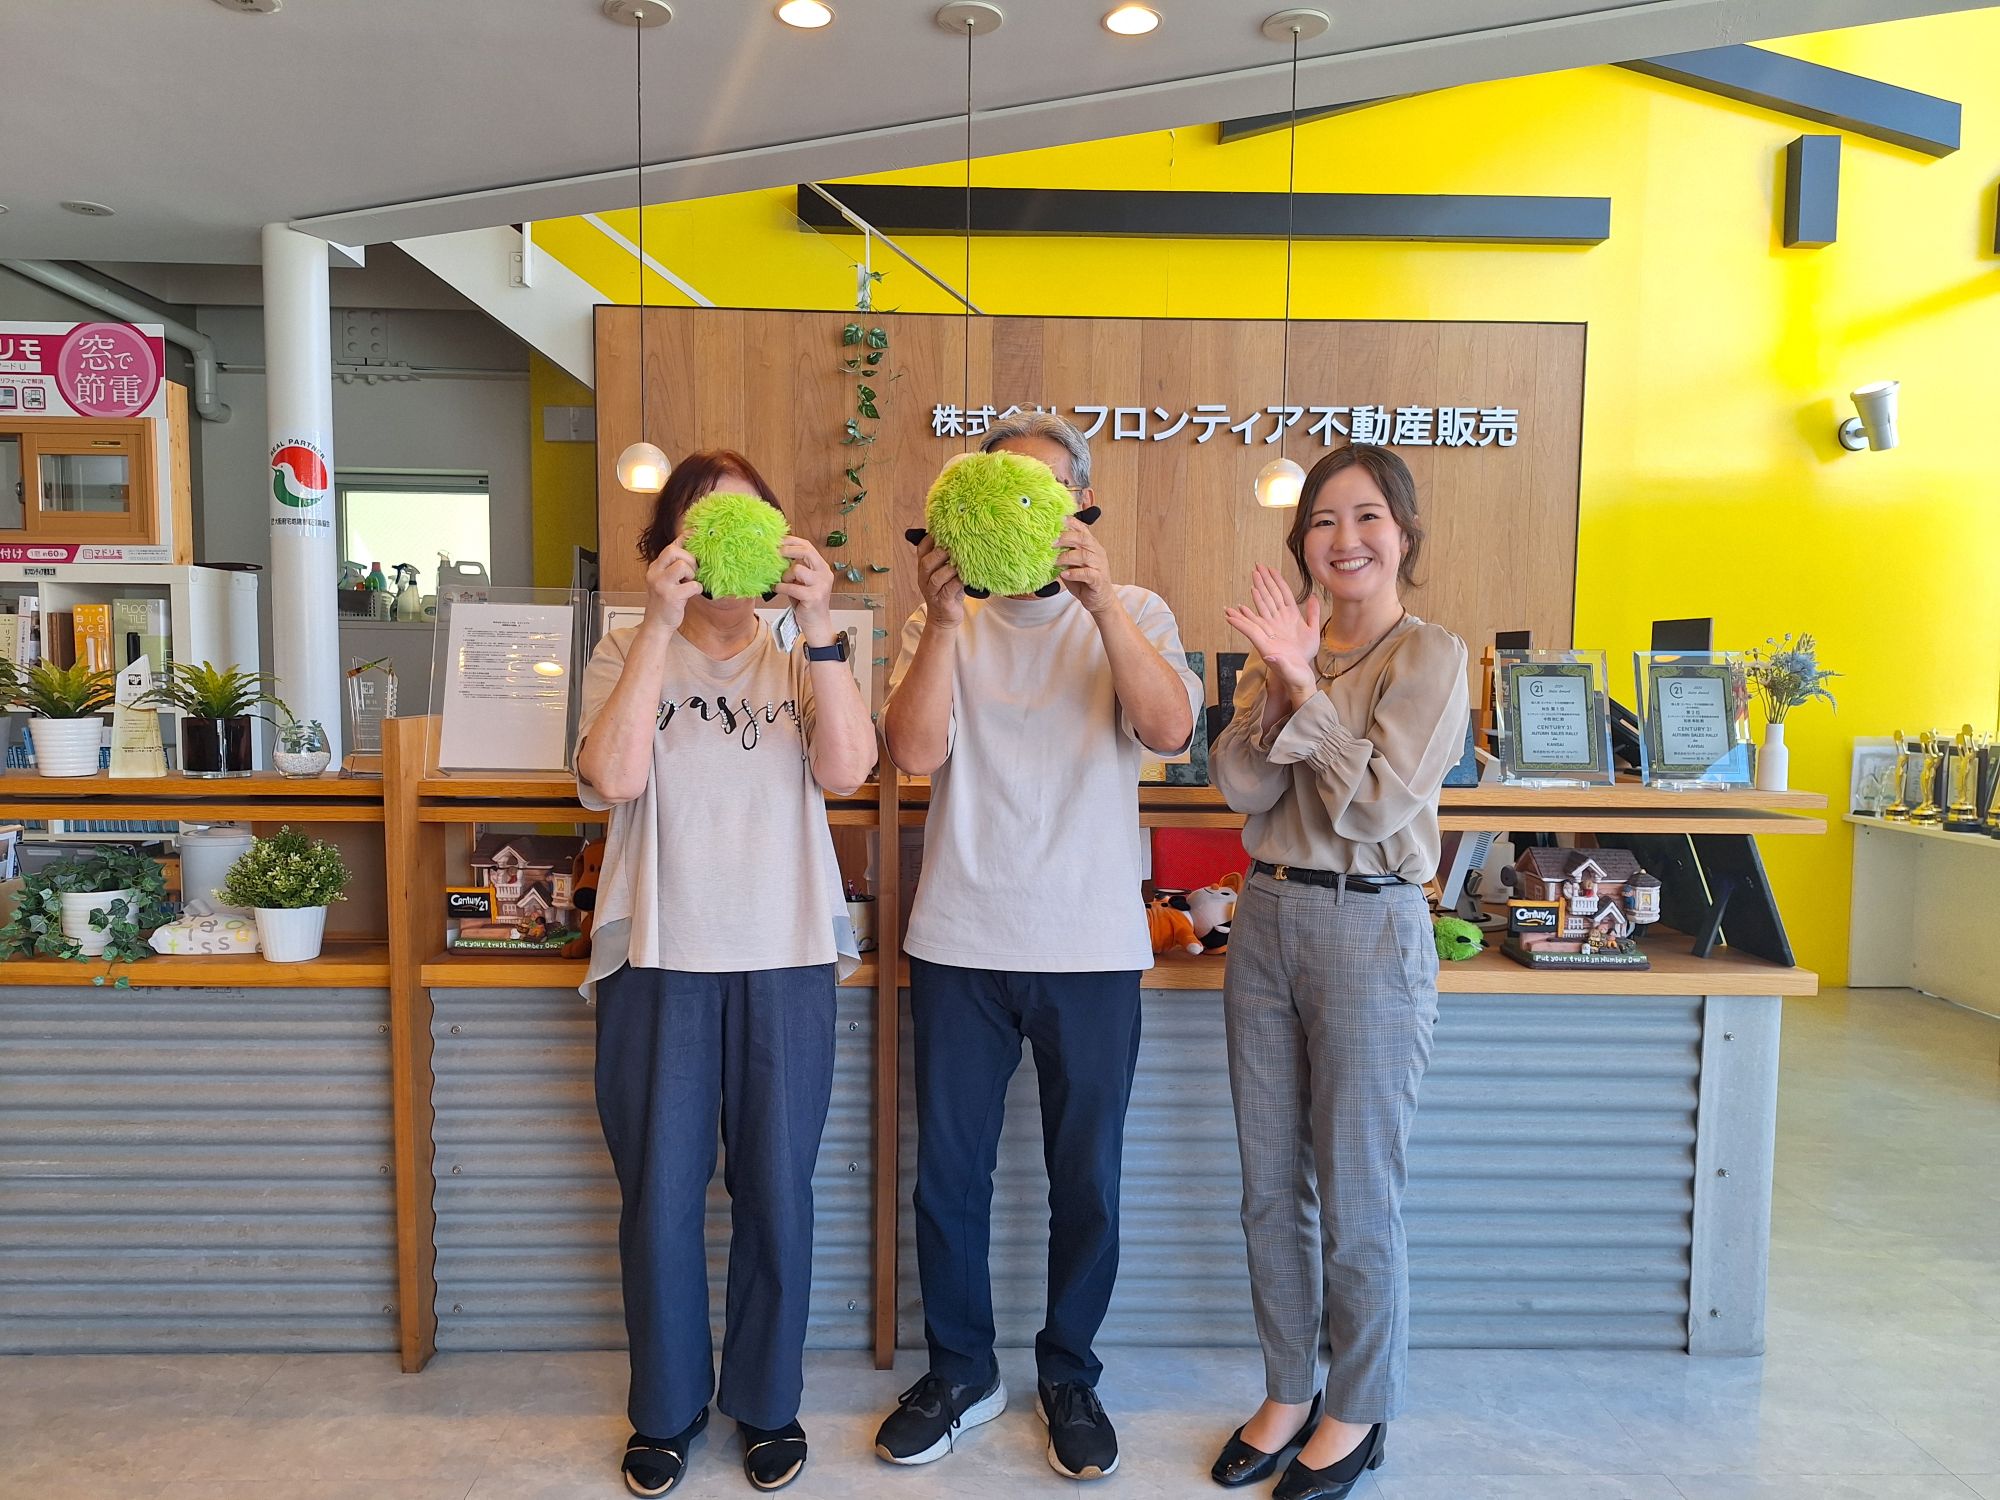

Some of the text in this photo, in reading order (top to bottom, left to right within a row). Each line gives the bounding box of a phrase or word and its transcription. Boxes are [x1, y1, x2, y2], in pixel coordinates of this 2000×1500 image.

[79, 335, 134, 370] 窓で
[75, 373, 143, 407] 節電
[121, 604, 153, 614] FLOOR
[76, 615, 105, 623] BIG
[128, 614, 146, 624] TILE
[76, 625, 105, 633] ACE
[450, 894, 489, 911] Century 21
[1515, 908, 1556, 926] Century 21
[455, 940, 468, 948] Put
[469, 941, 485, 950] your
[488, 941, 507, 949] trust
[508, 941, 517, 949] in
[517, 942, 543, 950] Number
